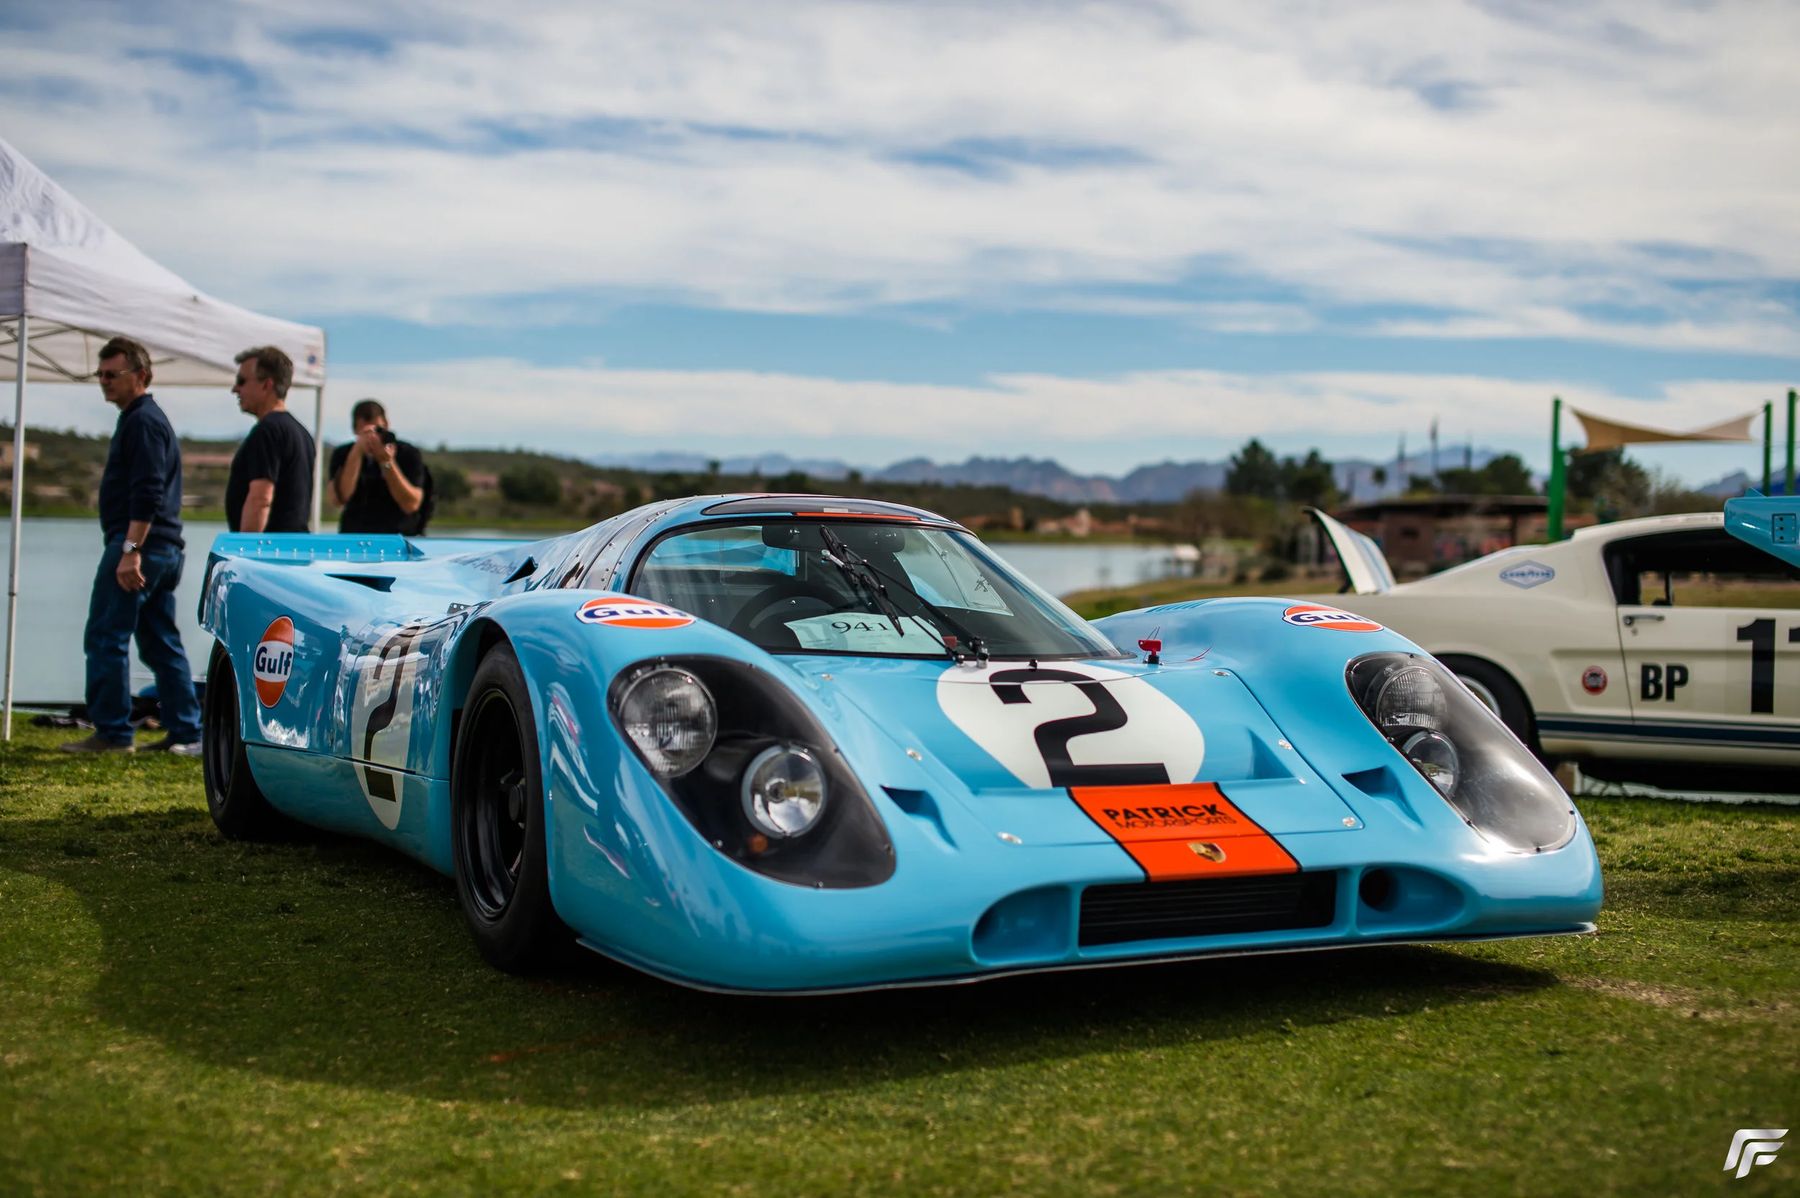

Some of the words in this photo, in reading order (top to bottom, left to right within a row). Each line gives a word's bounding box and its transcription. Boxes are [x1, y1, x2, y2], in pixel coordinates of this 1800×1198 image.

[831, 621, 891, 634] 941
[255, 646, 293, 676] Gulf
[1736, 618, 1800, 714] 1
[1640, 664, 1689, 702] BP
[363, 625, 421, 802] 2
[988, 668, 1172, 788] 2
[1102, 804, 1227, 821] PATRICK
[1114, 816, 1238, 829] MOTORSPORTS
